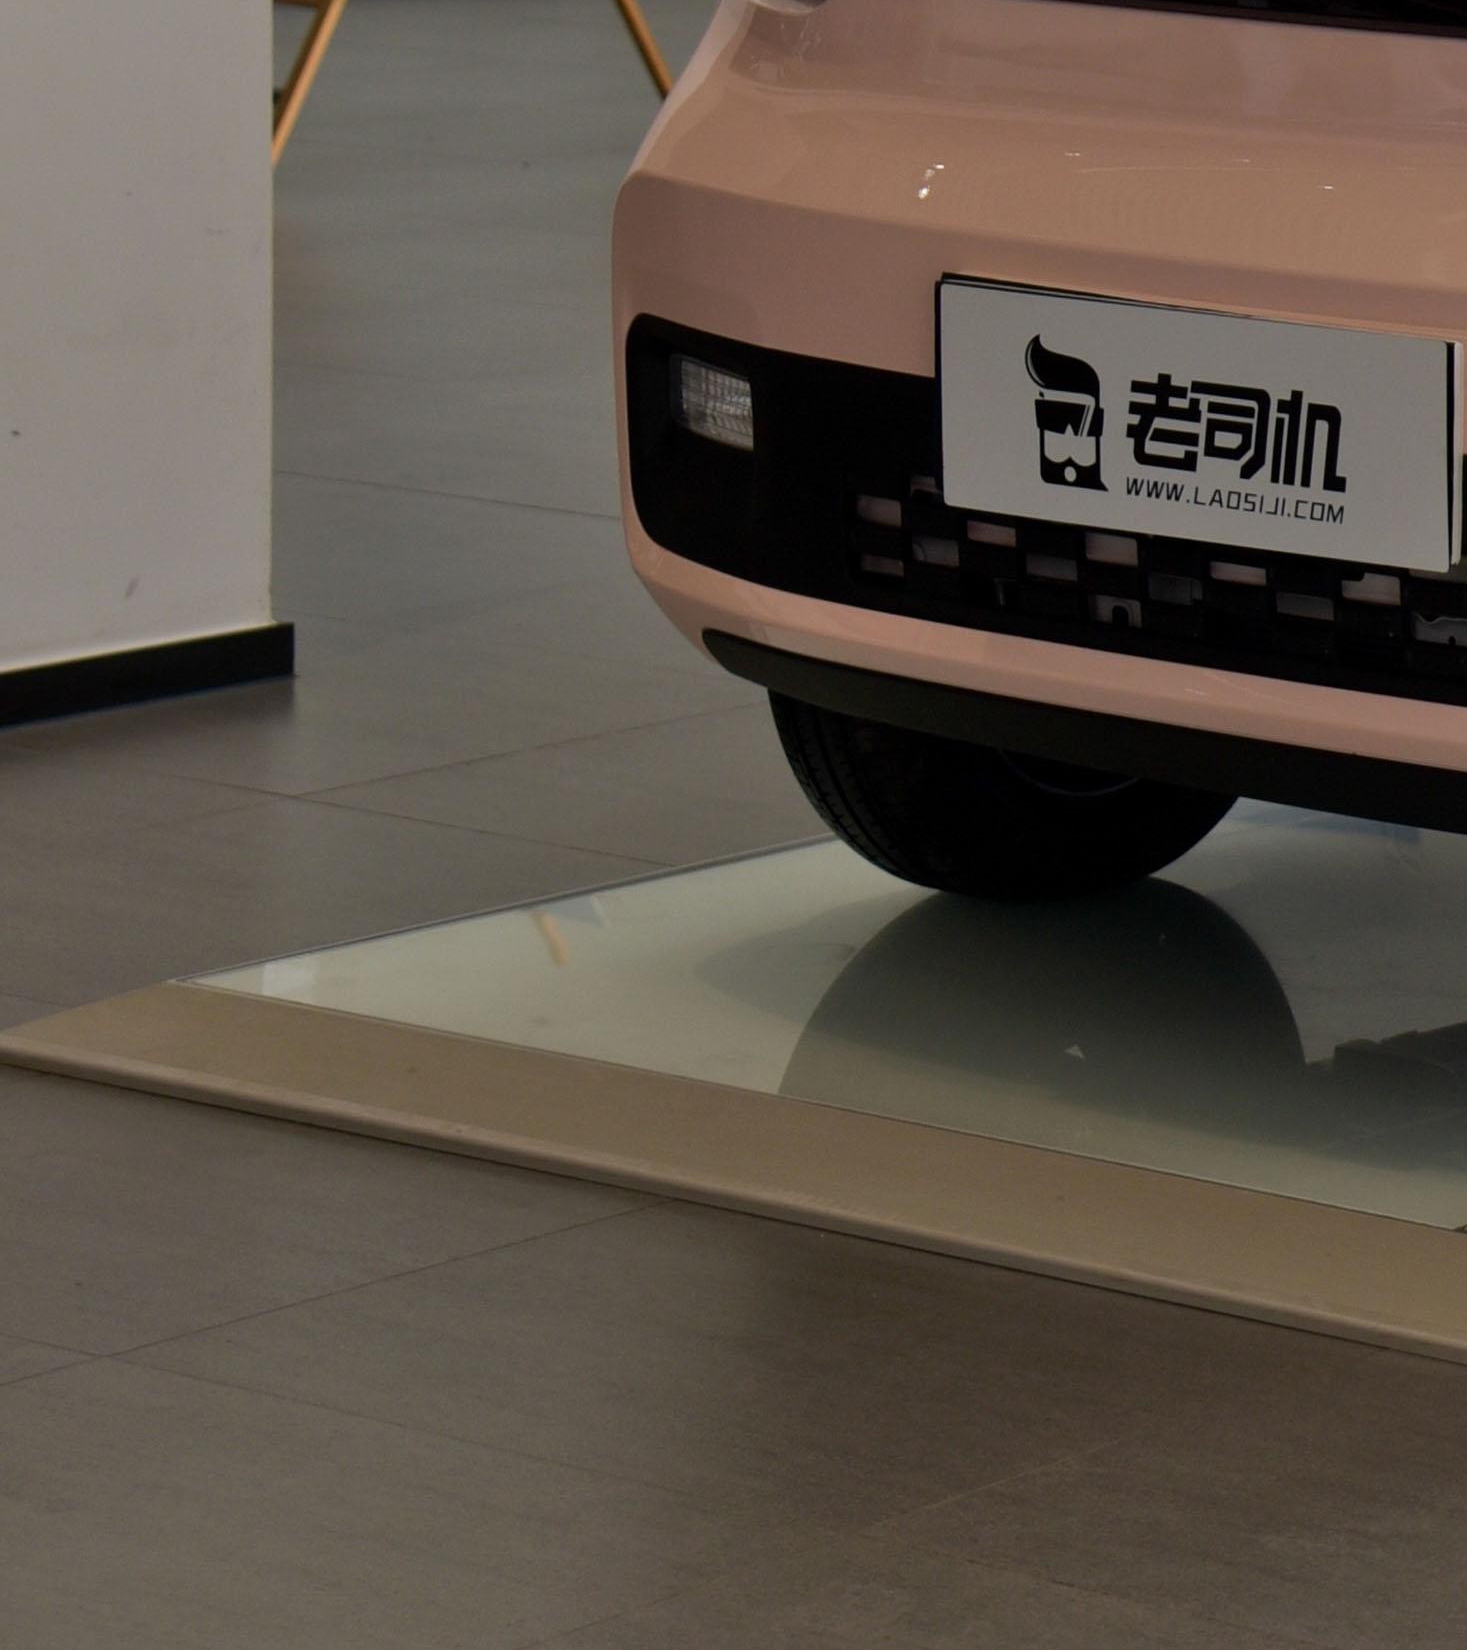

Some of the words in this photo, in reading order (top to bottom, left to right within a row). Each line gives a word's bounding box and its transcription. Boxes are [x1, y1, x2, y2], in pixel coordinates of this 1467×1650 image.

[1125, 373, 1347, 493] 老司机
[1125, 476, 1345, 525] WWW.LAOSIJI.COM
